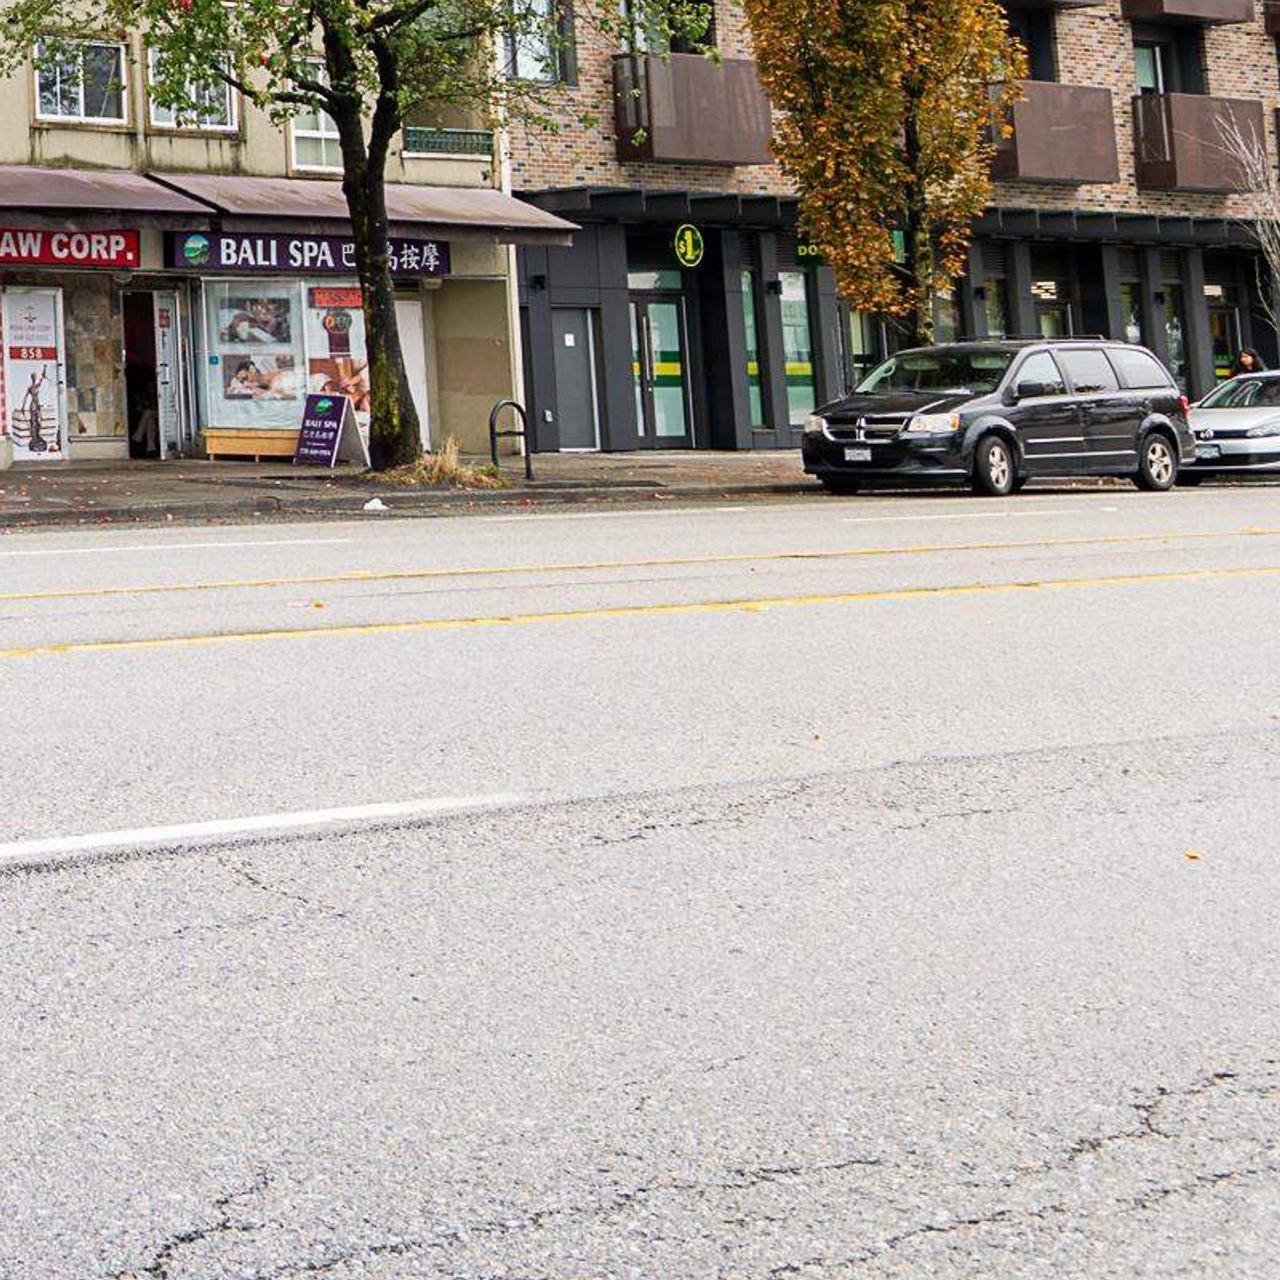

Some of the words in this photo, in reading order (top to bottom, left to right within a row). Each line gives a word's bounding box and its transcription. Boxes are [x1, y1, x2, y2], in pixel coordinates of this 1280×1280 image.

[51, 233, 133, 260] CORP.
[220, 238, 277, 266] BALI
[289, 240, 335, 268] SPA
